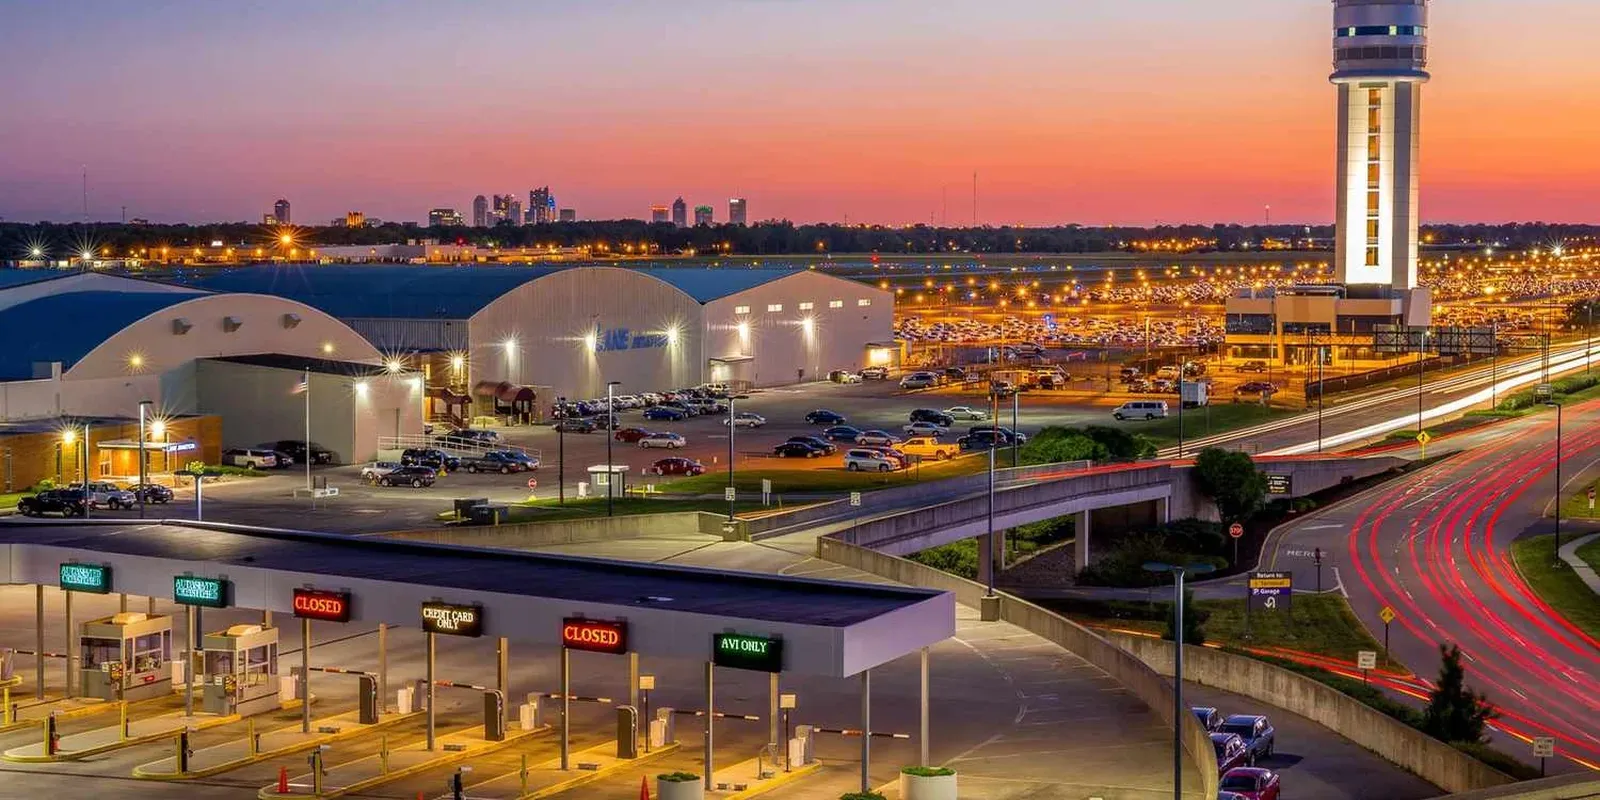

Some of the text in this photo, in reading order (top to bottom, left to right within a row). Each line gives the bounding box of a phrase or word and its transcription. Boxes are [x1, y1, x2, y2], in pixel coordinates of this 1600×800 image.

[295, 596, 341, 613] CLOSED
[423, 608, 474, 623] CREDIT CARD
[437, 618, 459, 630] ONLY
[565, 626, 618, 645] CLOSED
[721, 638, 767, 653] AVI ONLY
